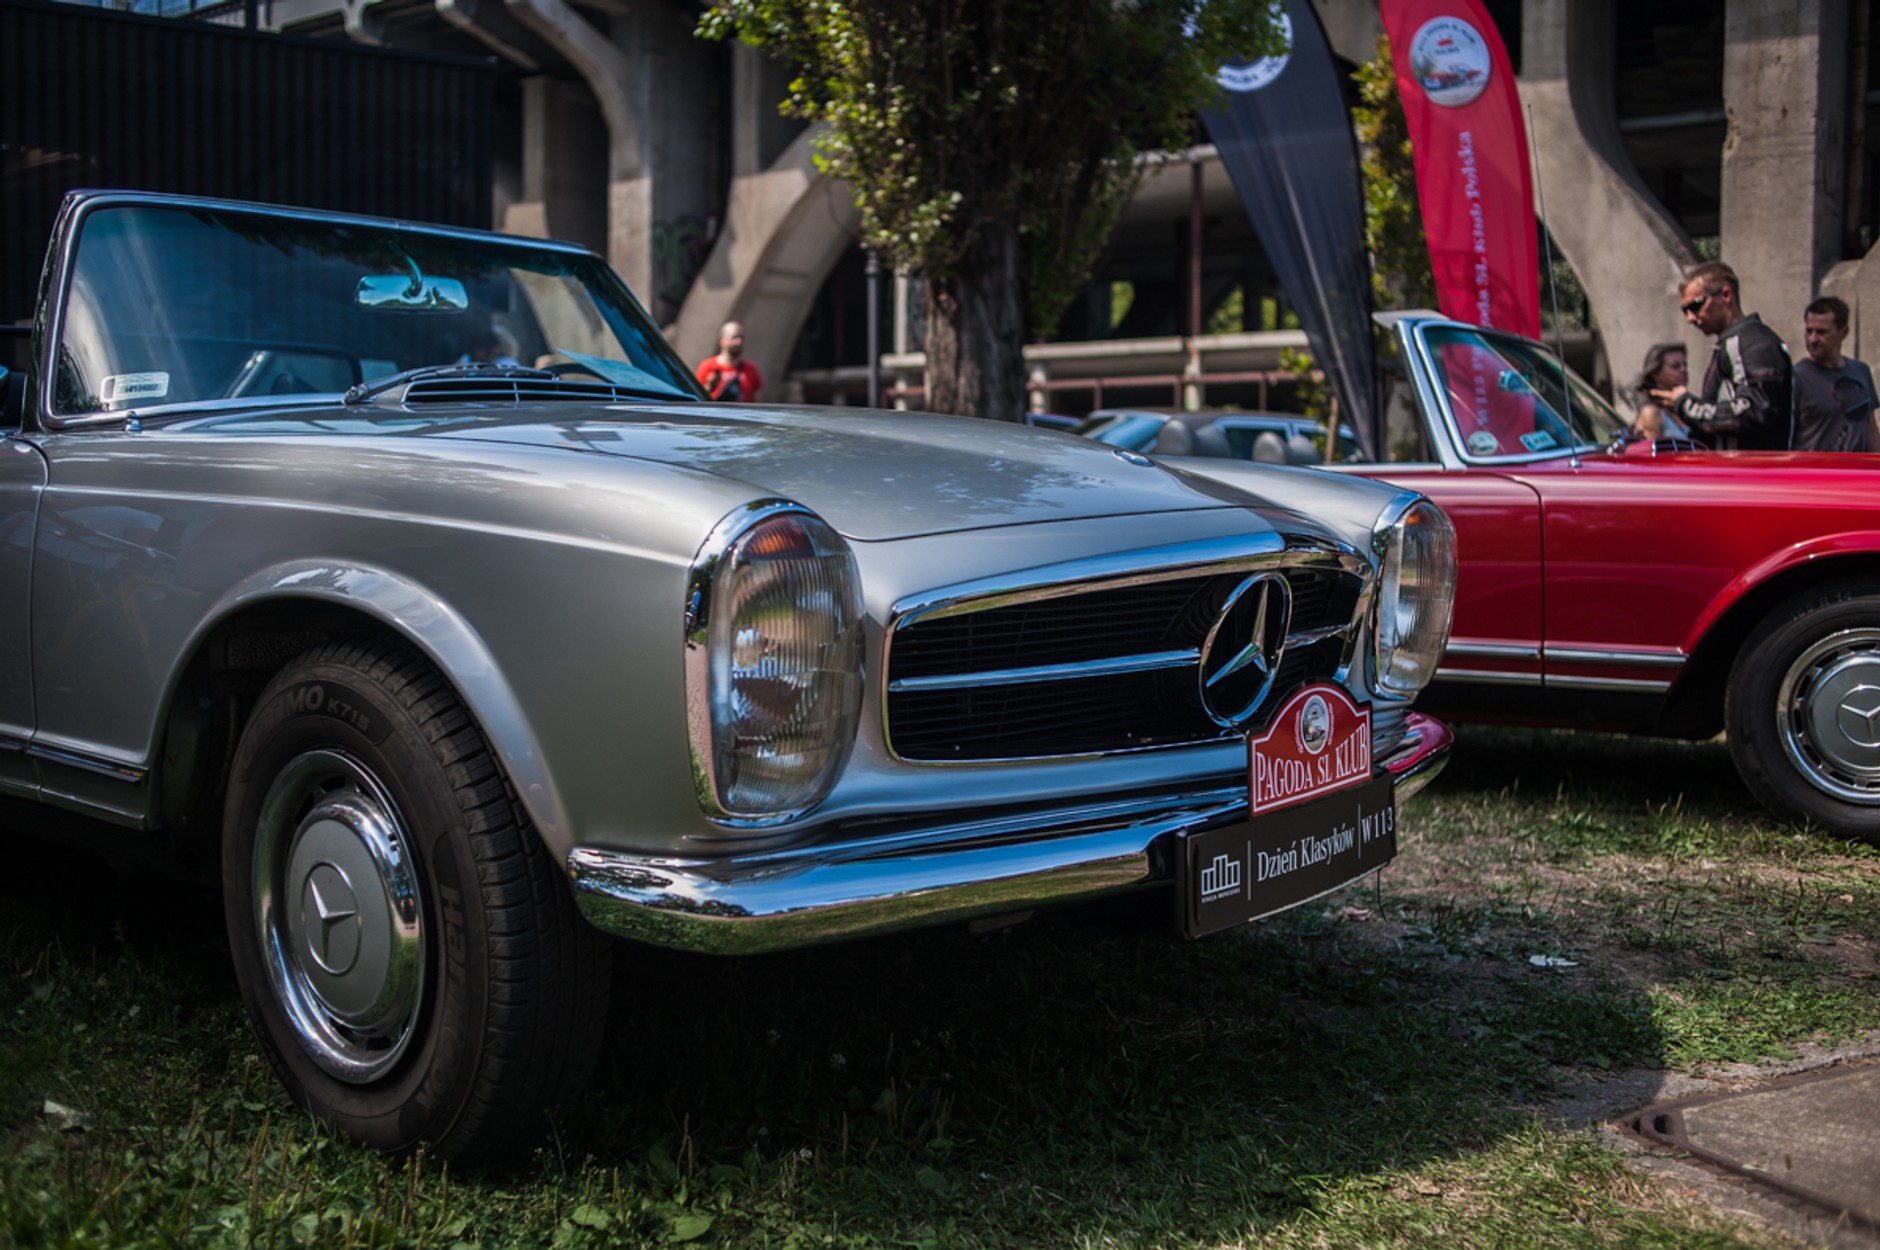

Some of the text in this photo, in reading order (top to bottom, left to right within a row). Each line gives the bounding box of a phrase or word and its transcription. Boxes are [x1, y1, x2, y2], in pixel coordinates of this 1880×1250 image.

[1458, 131, 1480, 199] Polska
[1470, 203, 1486, 253] Klub
[1475, 256, 1488, 285] SL
[327, 697, 370, 731] K715
[1256, 751, 1314, 804] PAGODA
[1317, 753, 1333, 783] SL
[1335, 722, 1368, 780] KLUB
[1257, 841, 1298, 882] Dzień
[1300, 822, 1355, 868] Klasyków
